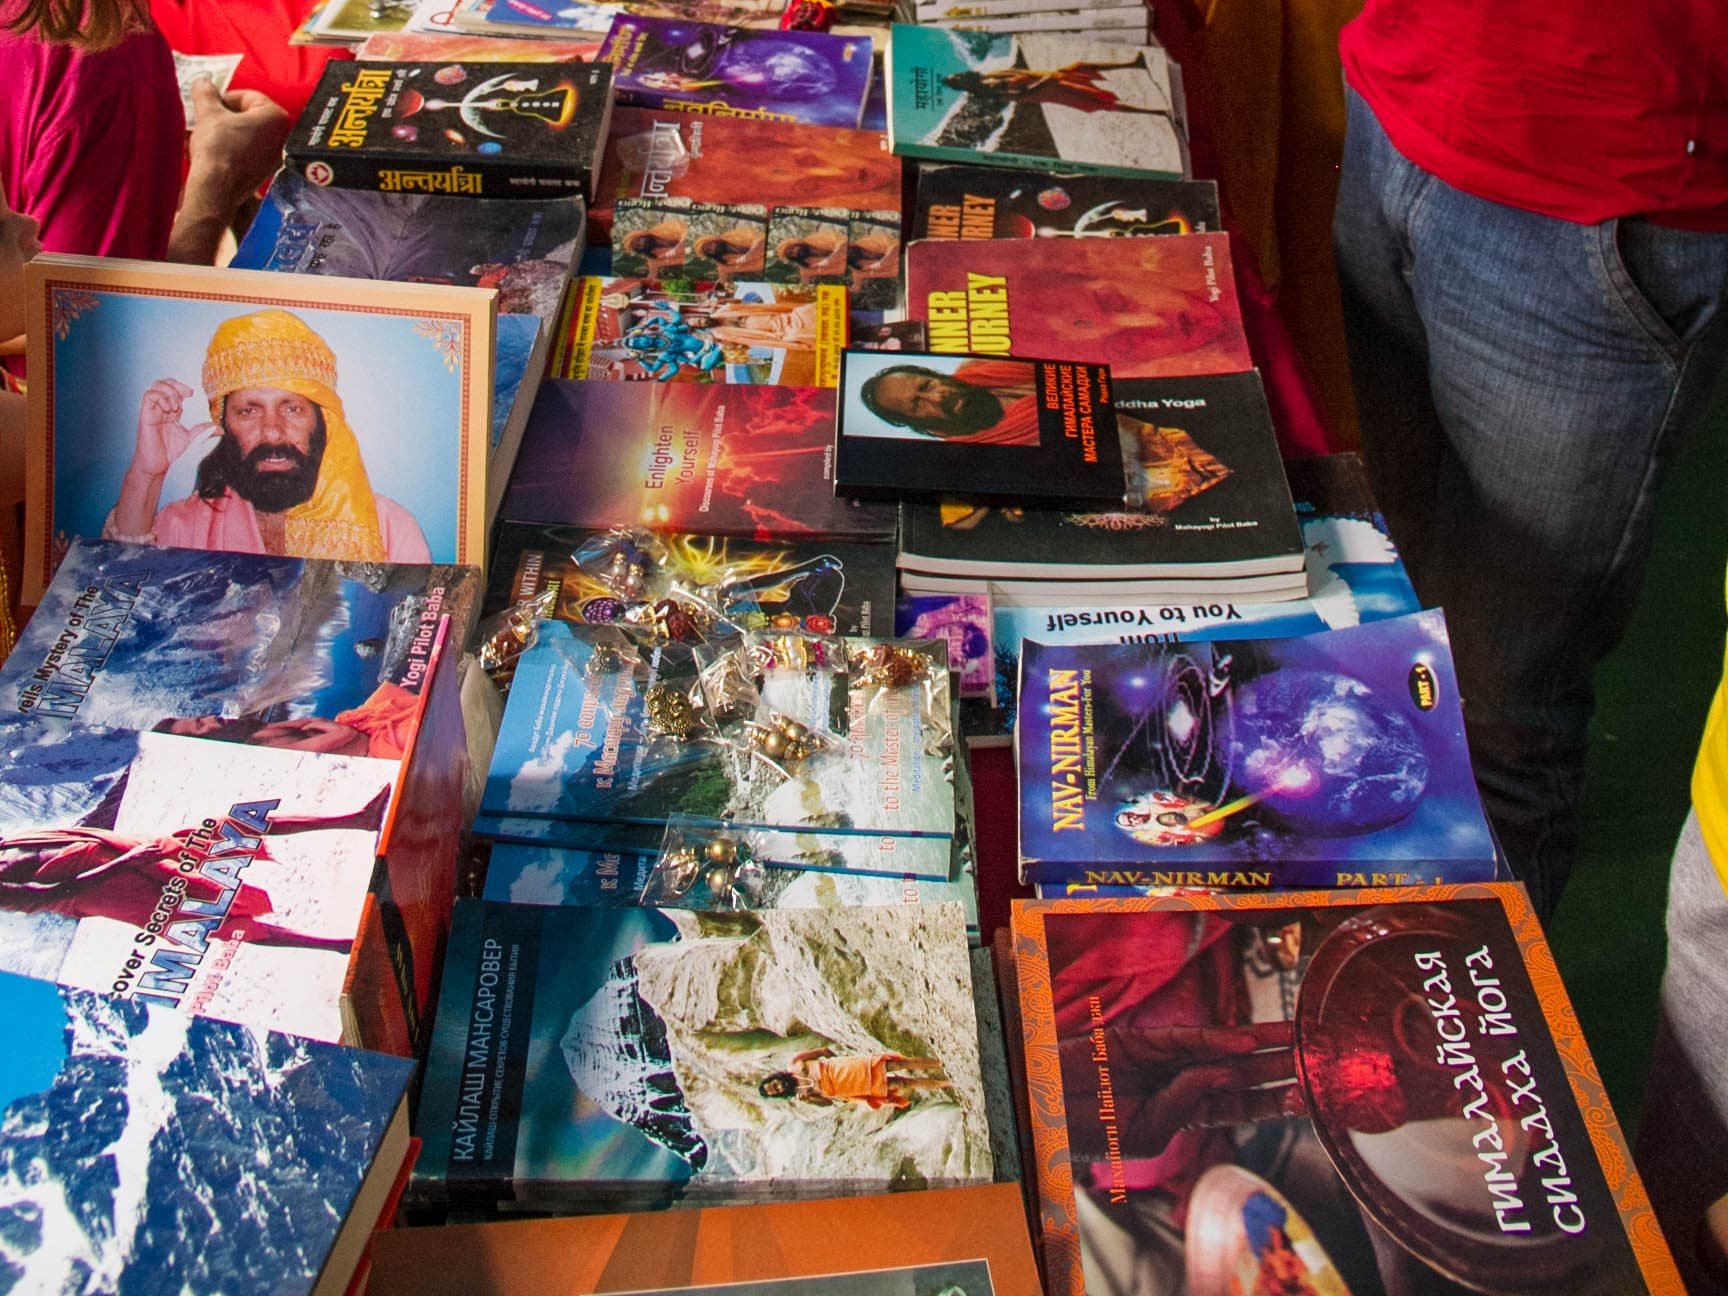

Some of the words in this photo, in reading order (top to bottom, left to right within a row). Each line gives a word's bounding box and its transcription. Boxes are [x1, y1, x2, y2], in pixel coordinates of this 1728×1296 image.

[927, 204, 961, 239] NER
[961, 193, 996, 239] RNEY
[967, 272, 1012, 356] URNEY
[1044, 364, 1059, 410] ВЕЛИКИЕ
[1060, 365, 1077, 438] ГИМАЛАЙСКИЕ
[1075, 365, 1092, 416] САМАДХИ
[1161, 397, 1207, 410] Yoga
[645, 425, 674, 489] Enlighten
[673, 430, 701, 485] Yourself
[1080, 417, 1098, 464] МАСТЕРА
[519, 554, 542, 596] WITHIN
[74, 585, 99, 609] The
[421, 586, 445, 621] Baba
[1160, 607, 1186, 622] to
[1193, 604, 1242, 620] You
[69, 612, 84, 627] of
[1046, 608, 1154, 632] Yourself
[33, 628, 78, 681] Mystery
[411, 624, 435, 655] Pilot
[400, 659, 427, 688] Yogi
[1081, 669, 1092, 692] You
[573, 731, 596, 749] 70
[880, 727, 899, 769] Master
[1049, 668, 1086, 832] NAV-NIRMAN
[1084, 741, 1099, 777] Himalayan
[880, 771, 899, 789] the
[1085, 780, 1097, 800] From
[884, 792, 899, 811] to
[185, 817, 217, 850] The
[880, 836, 896, 851] to
[178, 852, 199, 873] of
[1085, 870, 1271, 887] NAV-NIRMAN
[1336, 872, 1409, 887] PART
[135, 876, 188, 946] Secrets
[902, 888, 920, 903] to
[213, 929, 246, 970] Baba
[467, 938, 503, 1068] МАНСАРОВЕР
[1089, 995, 1103, 1025] джи
[1089, 1027, 1107, 1062] Баба
[1097, 1066, 1116, 1121] Пайлот
[452, 1073, 485, 1161] КАЙЛАШ
[1105, 1125, 1128, 1204] Махайоги
